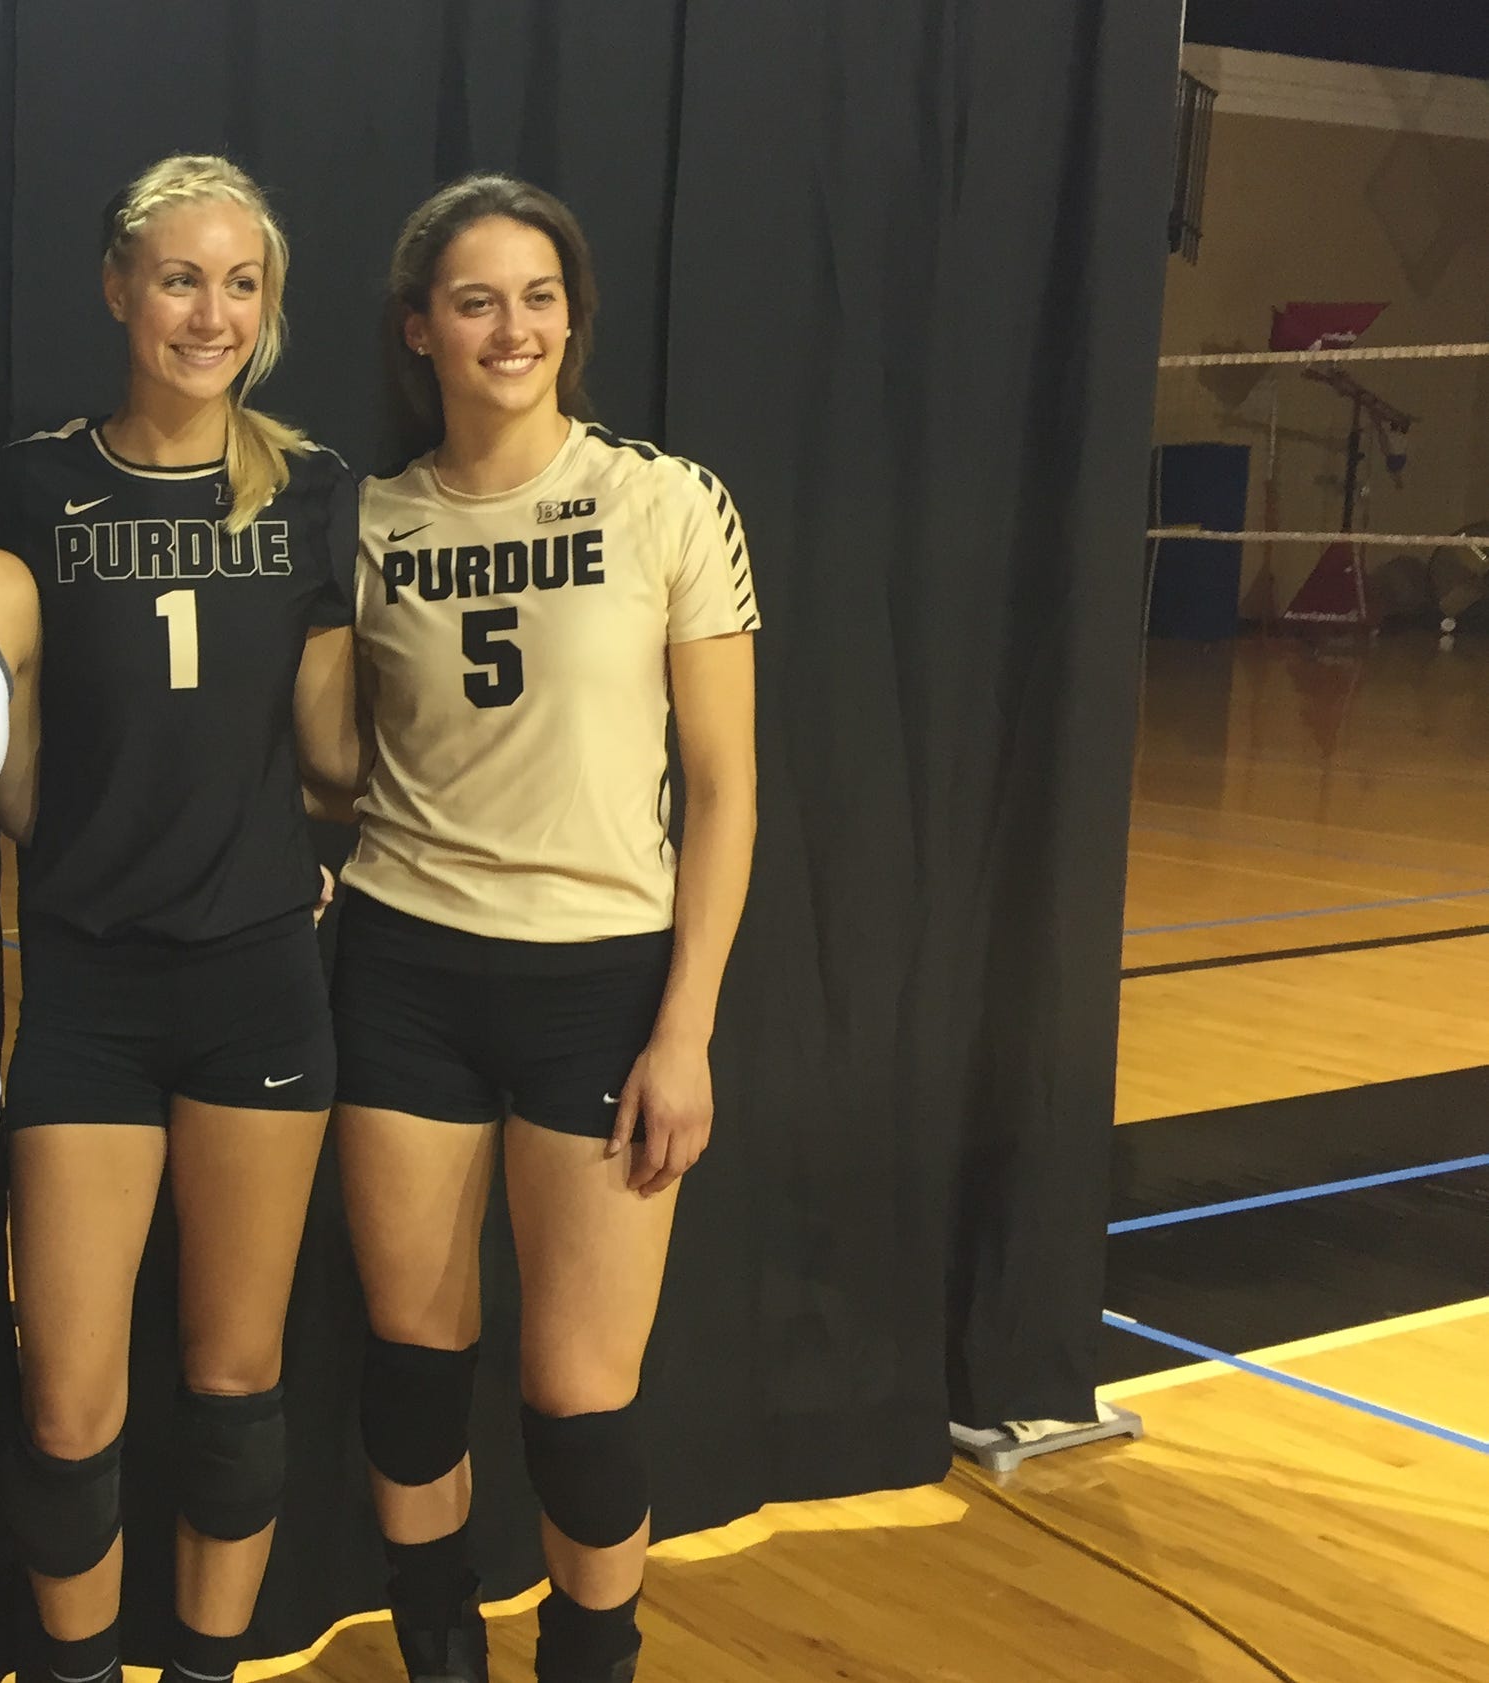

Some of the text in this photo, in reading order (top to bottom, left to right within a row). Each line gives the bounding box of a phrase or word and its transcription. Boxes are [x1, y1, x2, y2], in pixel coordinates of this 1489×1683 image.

[55, 519, 293, 583] PURDUE
[382, 529, 605, 605] PURDUE
[155, 589, 199, 690] 1
[461, 606, 525, 709] 5
